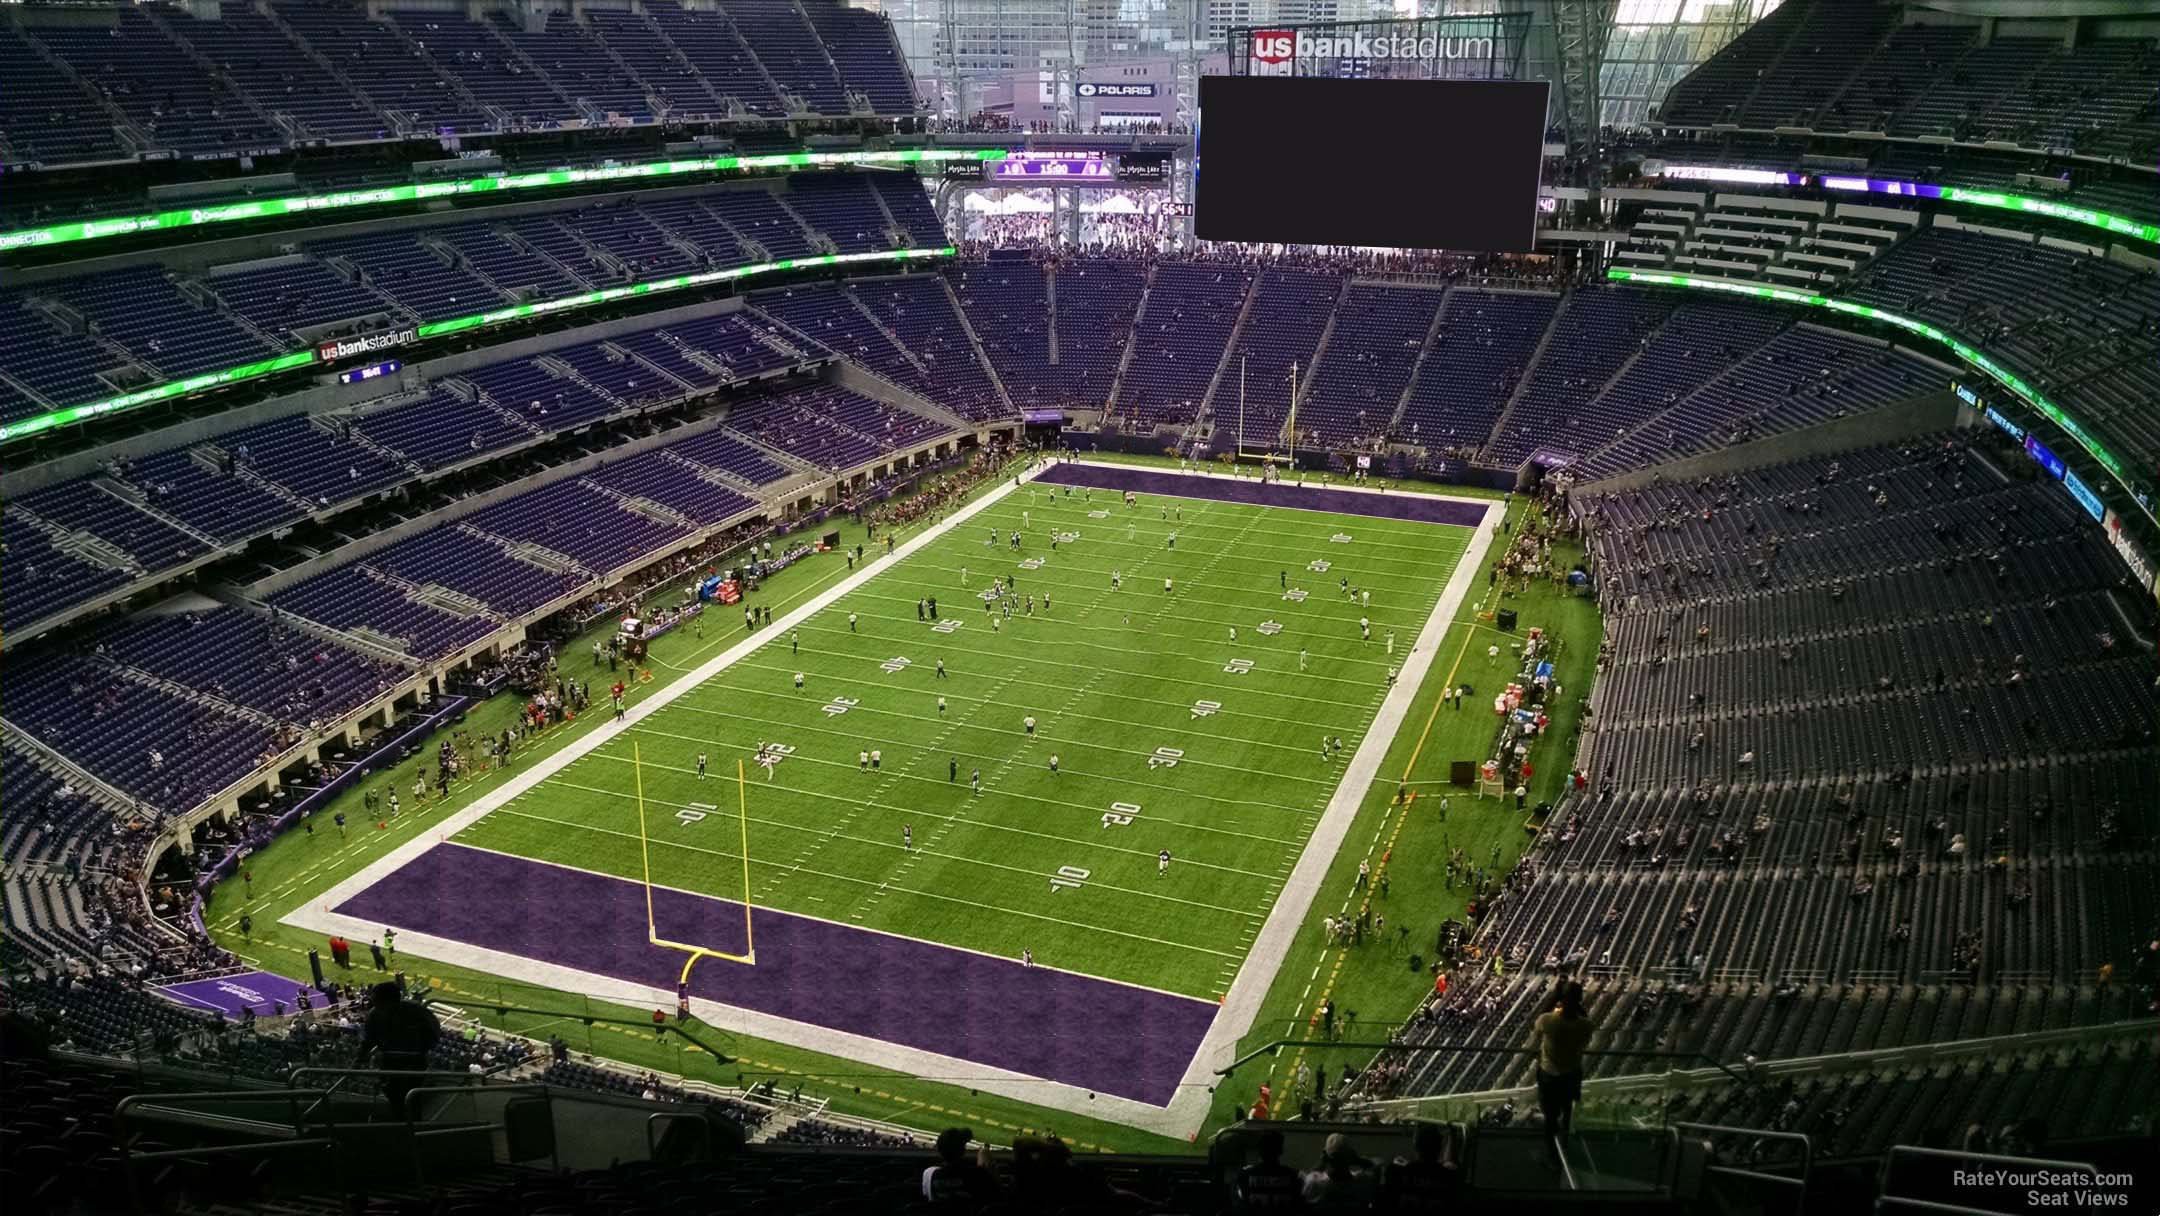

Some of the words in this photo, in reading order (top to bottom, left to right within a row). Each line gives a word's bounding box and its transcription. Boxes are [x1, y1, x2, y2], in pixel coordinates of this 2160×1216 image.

[1098, 86, 1152, 95] POLARIS
[1162, 203, 1192, 215] 56:41
[1223, 658, 1255, 674] 50
[821, 696, 861, 714] 30
[1190, 699, 1222, 717] 40
[1147, 746, 1185, 768] 30
[674, 802, 718, 821] 10
[1100, 801, 1142, 826] 20
[1050, 865, 1092, 888] 10
